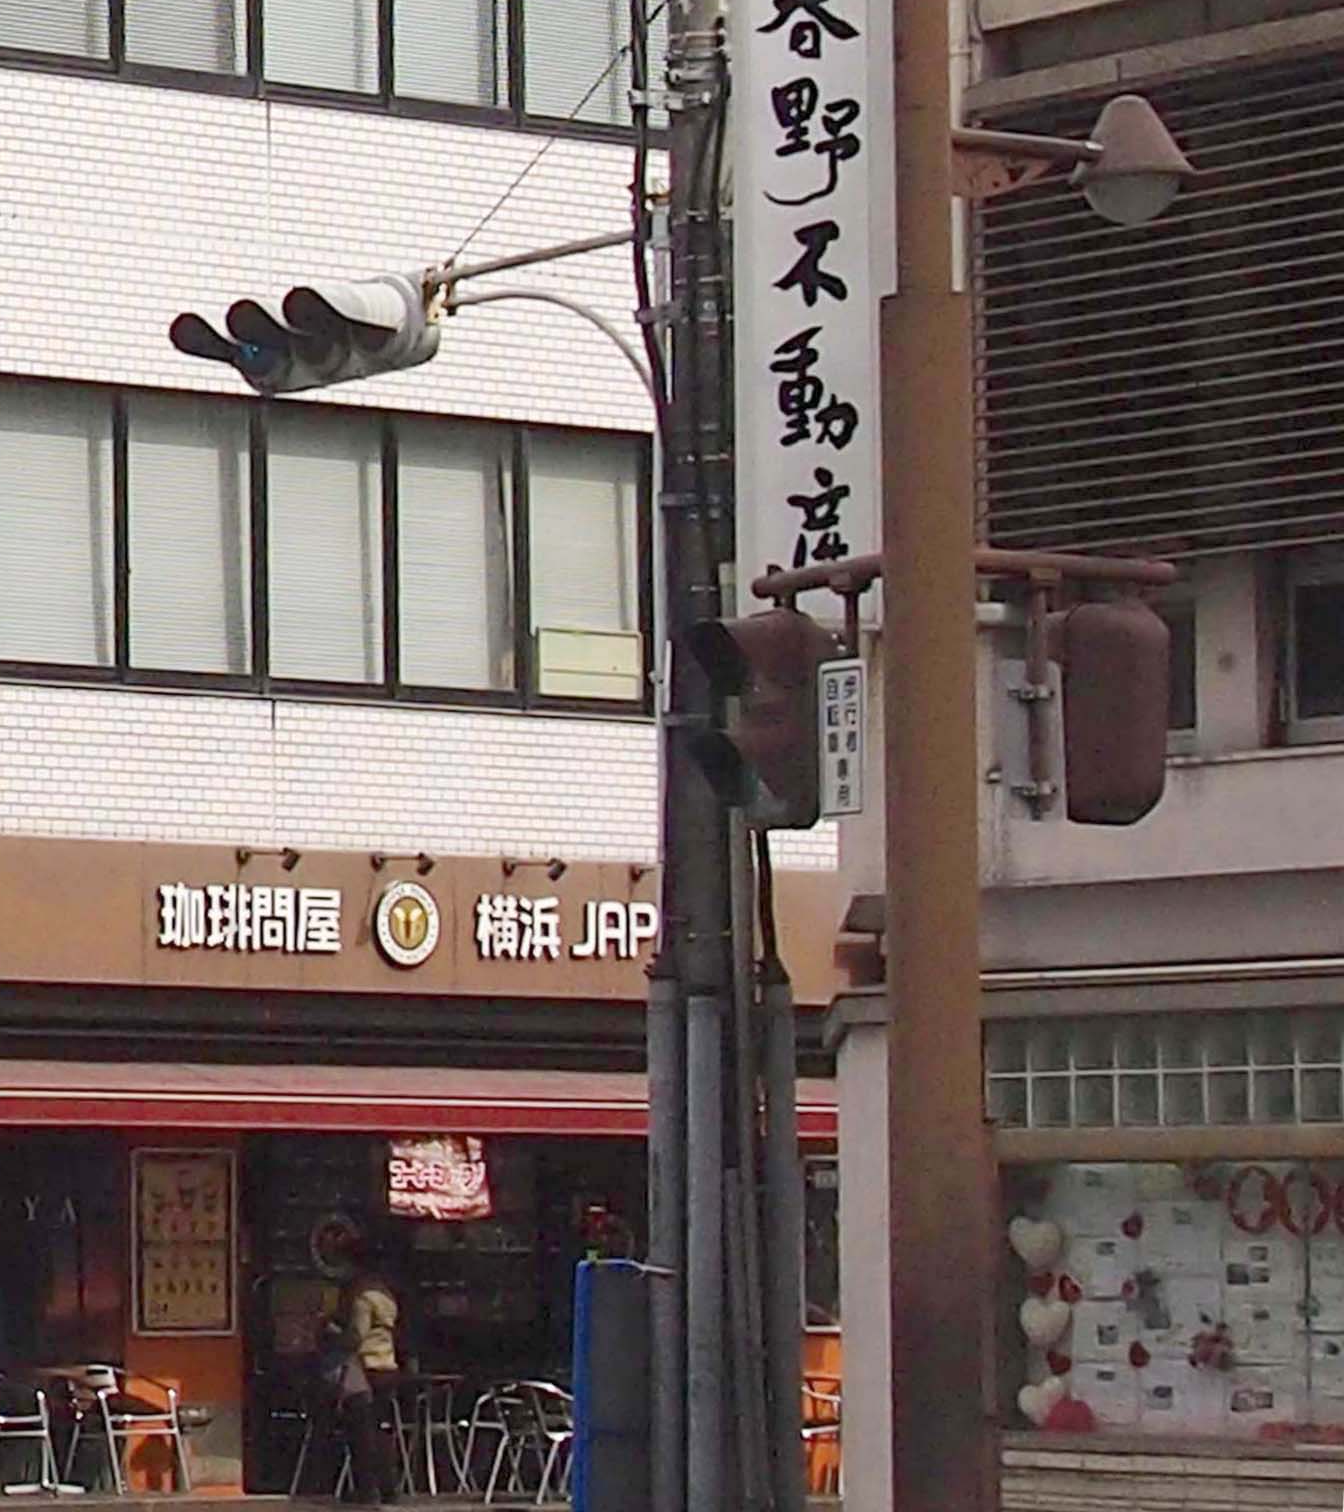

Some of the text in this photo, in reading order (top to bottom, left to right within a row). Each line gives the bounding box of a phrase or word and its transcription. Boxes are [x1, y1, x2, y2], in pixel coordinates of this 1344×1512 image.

[159, 882, 659, 959] 珈琲問屋 横浜 JAP
